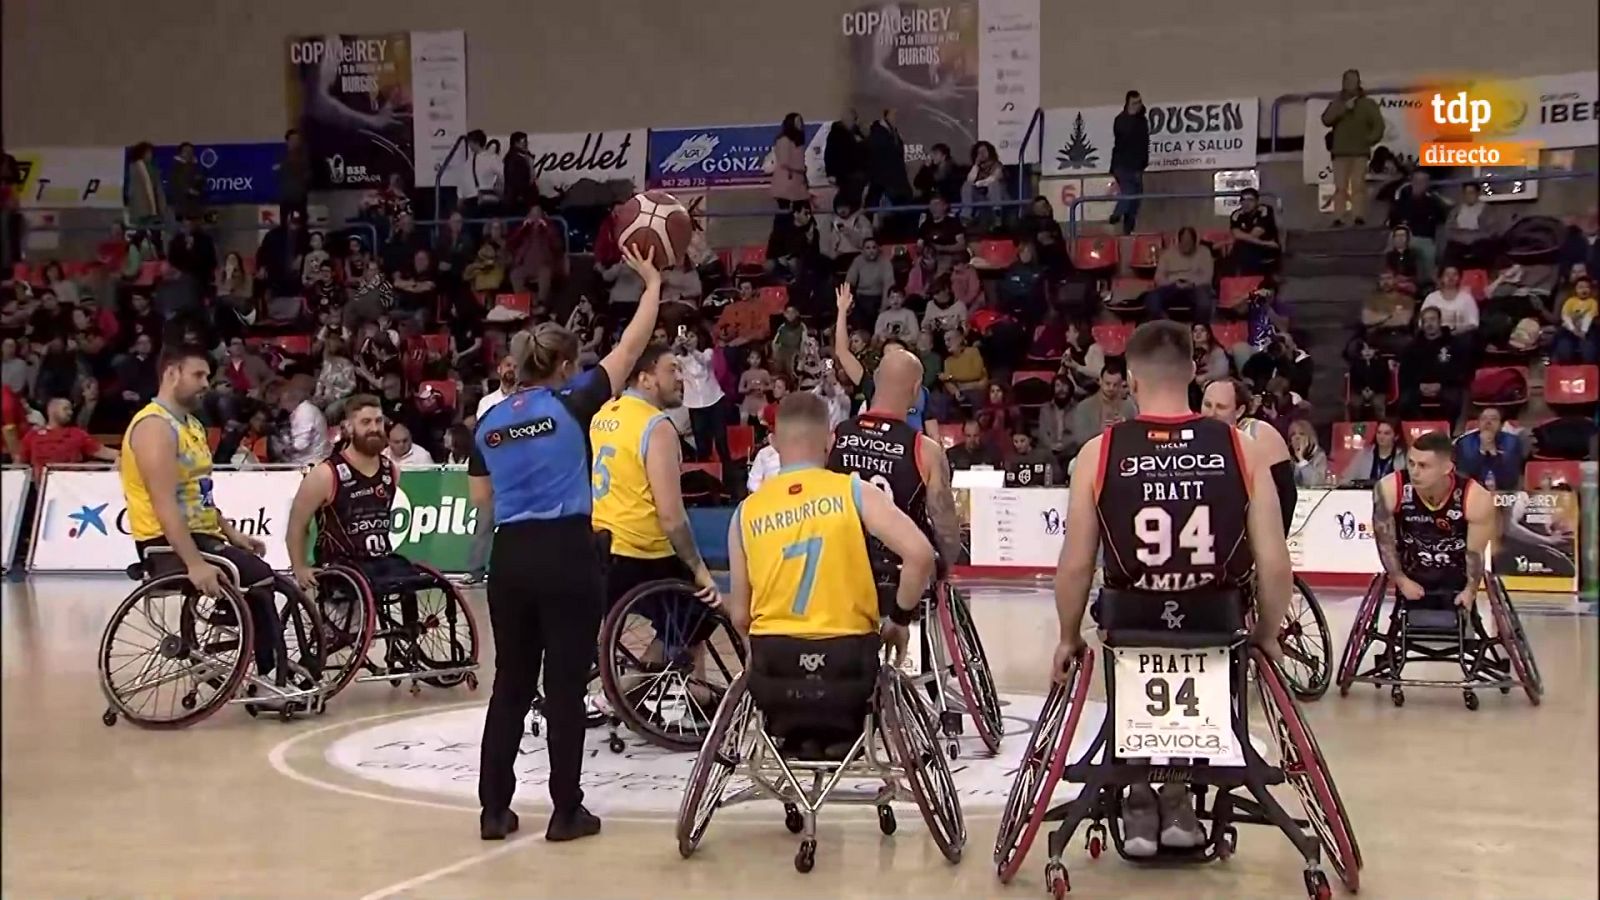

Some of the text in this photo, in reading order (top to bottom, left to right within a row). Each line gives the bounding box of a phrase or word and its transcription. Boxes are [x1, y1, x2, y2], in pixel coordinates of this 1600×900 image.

[898, 47, 940, 66] BURGOS
[1186, 140, 1195, 151] Y
[1199, 138, 1243, 151] SALUD
[702, 152, 764, 173] GÓNZ
[1061, 184, 1077, 206] 6
[509, 417, 553, 439] bequal
[836, 434, 904, 455] gaviota
[842, 454, 893, 474] FILIPSKI
[1120, 454, 1225, 477] gaviota
[1142, 481, 1204, 501] PRATT
[749, 496, 844, 538] WARBURTON
[1134, 505, 1216, 567] 94
[782, 536, 823, 615] 7
[1138, 653, 1208, 674] PRATT
[1145, 677, 1200, 717] 94
[1126, 733, 1221, 752] gaviota
